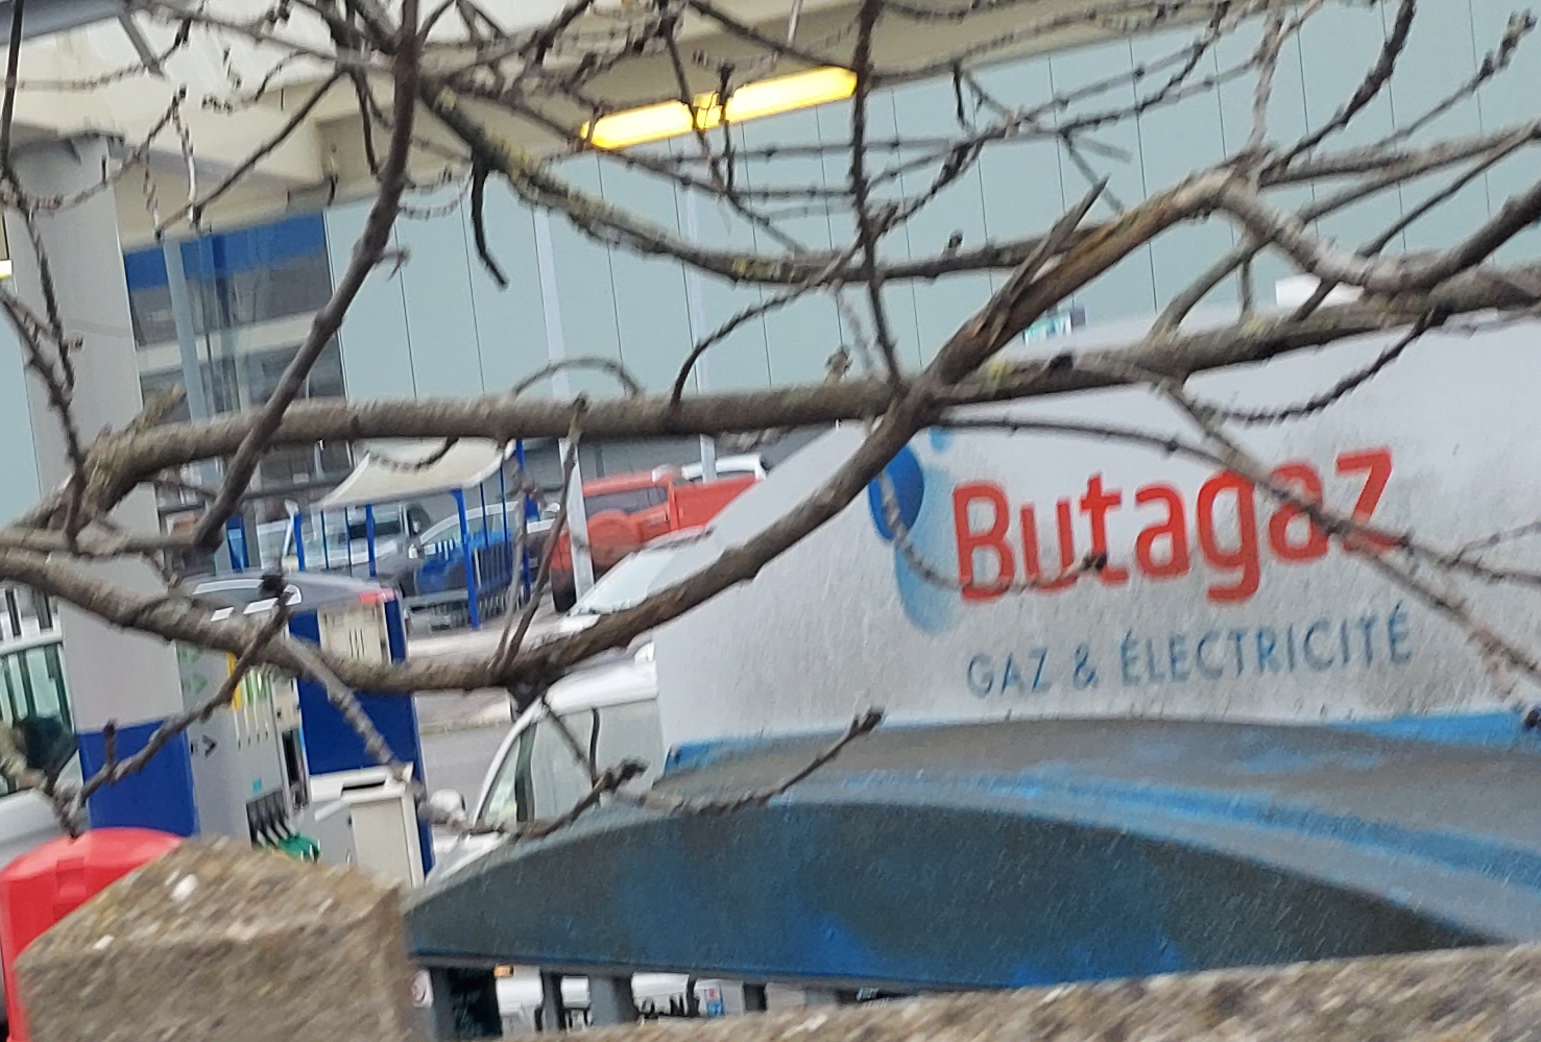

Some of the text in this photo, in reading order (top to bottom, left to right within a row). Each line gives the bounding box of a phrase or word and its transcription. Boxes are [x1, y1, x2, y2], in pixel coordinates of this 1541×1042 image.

[953, 447, 1400, 604] Butagaz
[966, 602, 1415, 699] GAZ & ÉLECTRICITÉ
